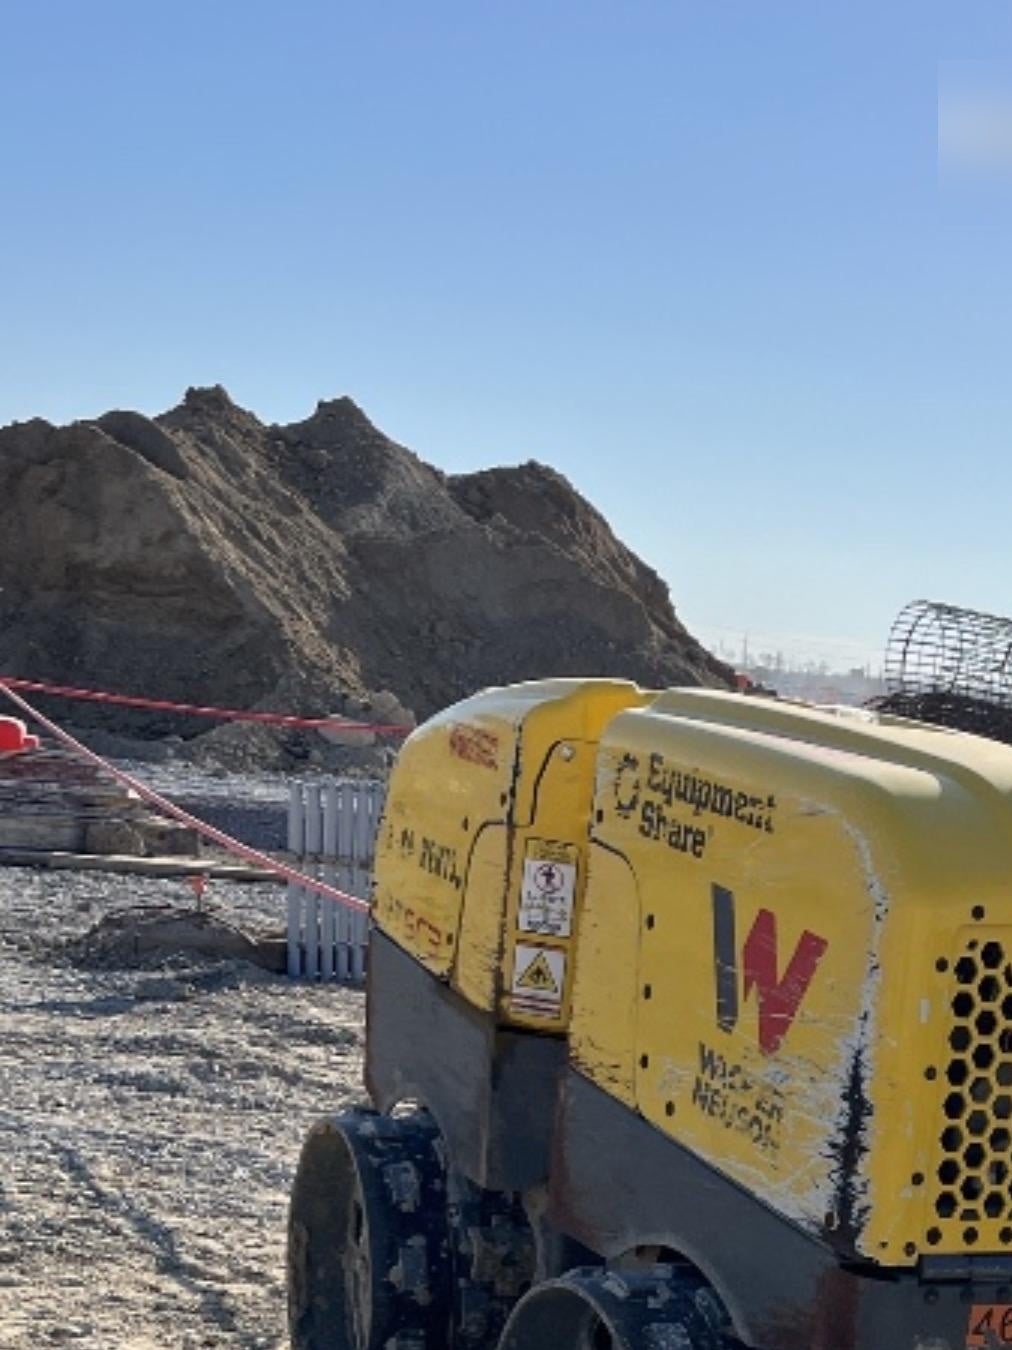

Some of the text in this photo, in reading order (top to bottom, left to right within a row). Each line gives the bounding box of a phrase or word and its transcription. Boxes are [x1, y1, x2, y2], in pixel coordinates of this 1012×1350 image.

[639, 800, 706, 859] Share
[648, 752, 776, 835] Equipment
[711, 881, 829, 1057] W
